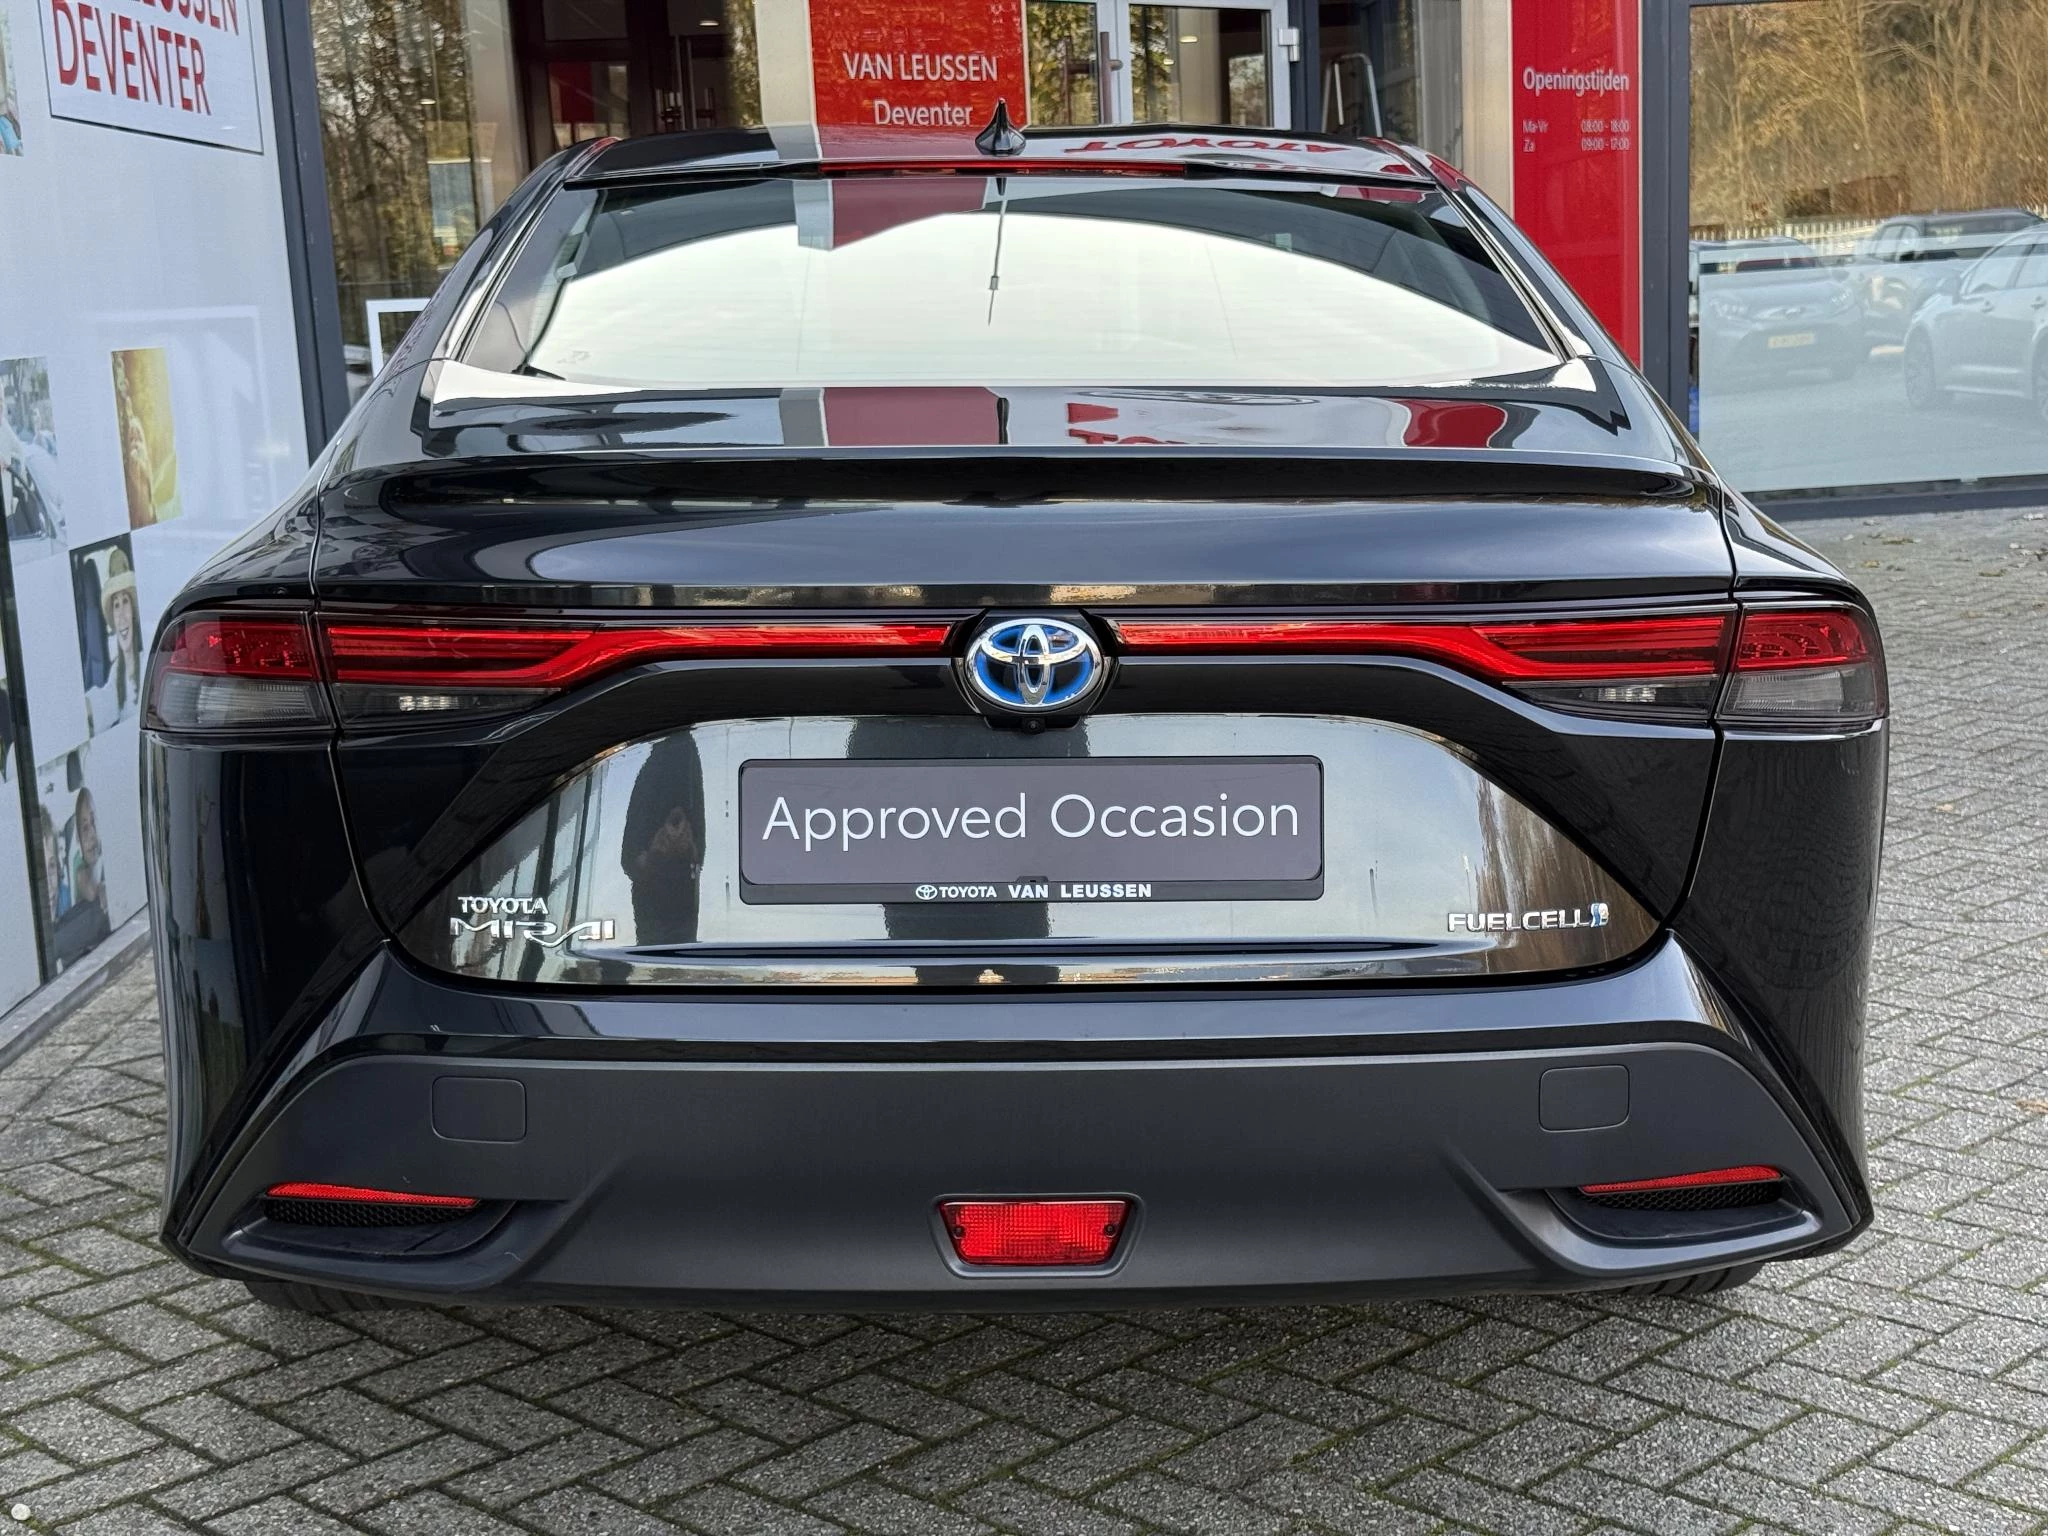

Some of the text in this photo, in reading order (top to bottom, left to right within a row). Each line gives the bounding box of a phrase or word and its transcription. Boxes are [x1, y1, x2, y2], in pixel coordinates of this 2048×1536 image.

[52, 0, 212, 116] DEVENTER
[843, 52, 998, 81] VAN LEUSSEN
[1523, 67, 1630, 97] Openingstijden
[873, 99, 973, 126] Deventer
[762, 792, 1298, 852] Approved Occasion
[457, 896, 549, 914] TOYOTA
[939, 884, 1152, 899] TOYOTA VAN LEUSSEN
[450, 917, 616, 948] MIRAI
